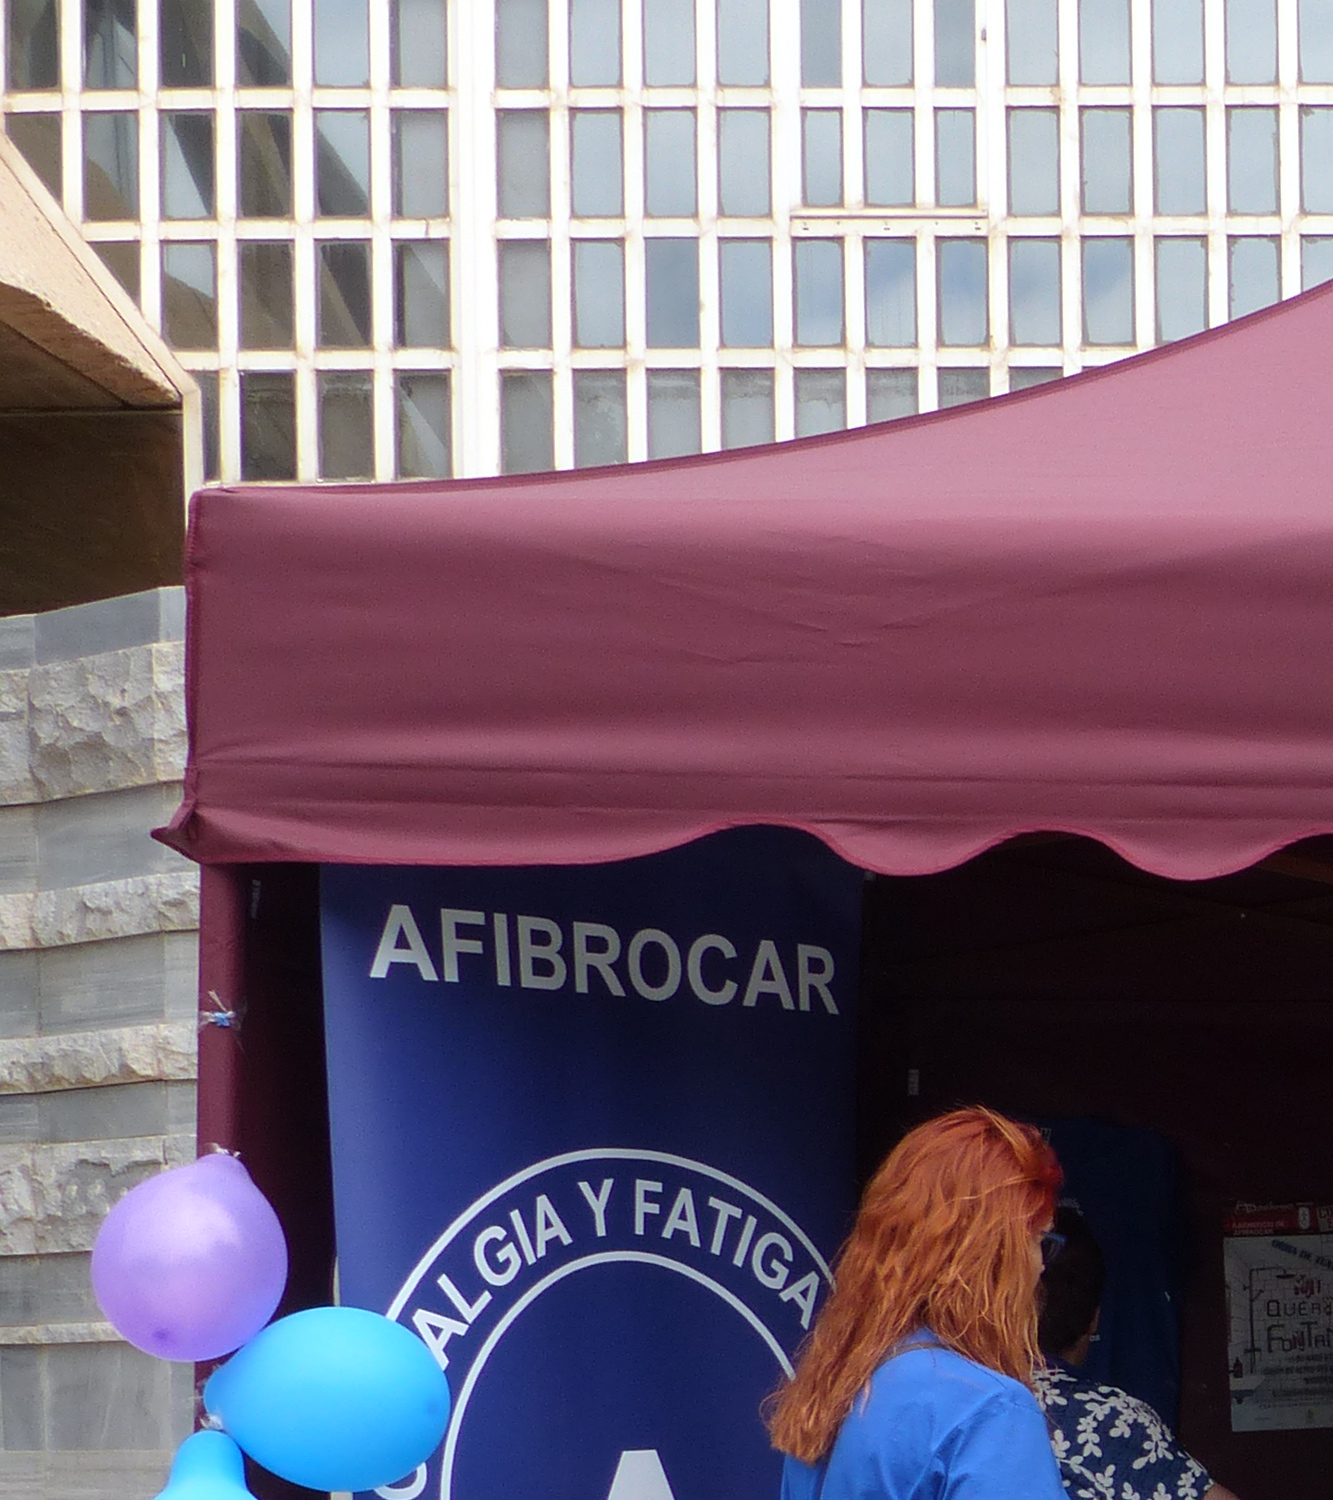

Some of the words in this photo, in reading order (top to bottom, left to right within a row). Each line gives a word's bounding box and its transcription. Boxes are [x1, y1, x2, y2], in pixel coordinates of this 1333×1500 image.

[368, 904, 841, 1016] AFIBROCAR
[557, 1177, 614, 1237] Y
[634, 1178, 821, 1331] FATIGA
